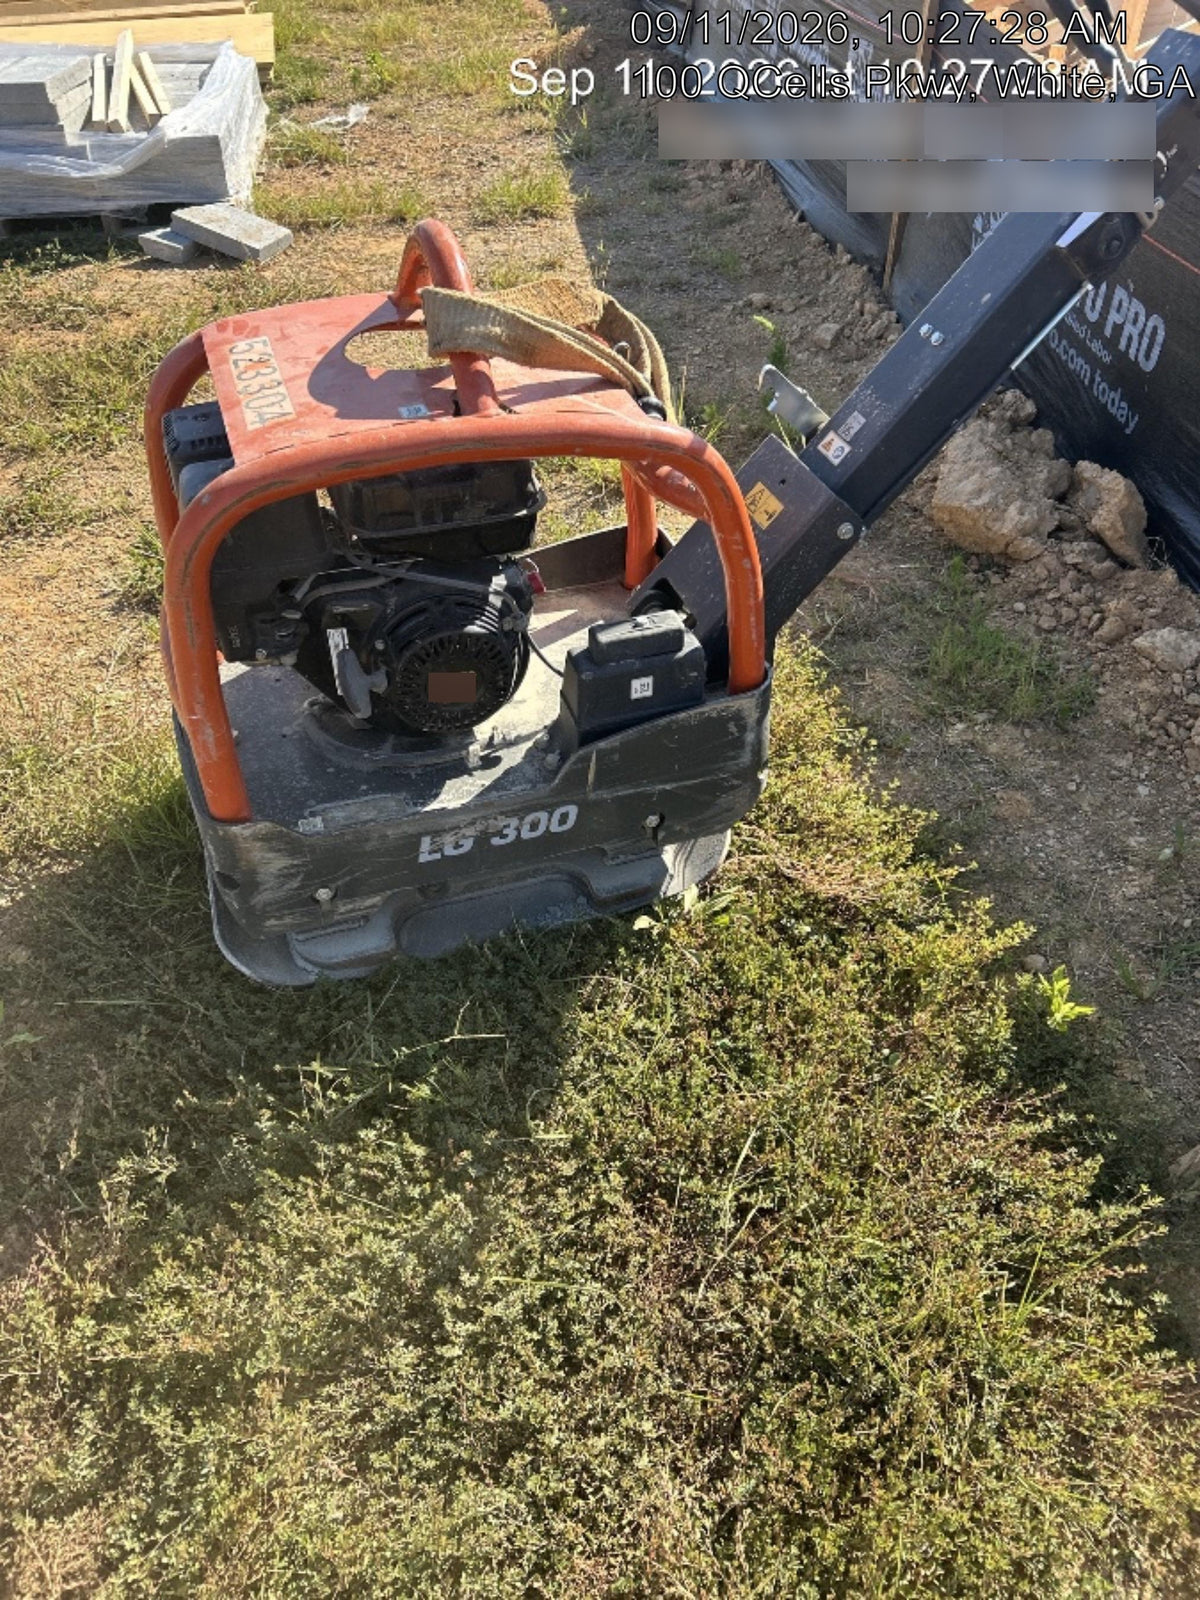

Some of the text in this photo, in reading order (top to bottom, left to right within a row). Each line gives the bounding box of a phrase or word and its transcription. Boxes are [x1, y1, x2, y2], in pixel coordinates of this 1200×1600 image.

[1104, 283, 1166, 372] PRO
[1092, 368, 1139, 435] today
[417, 803, 579, 864] LG 300
